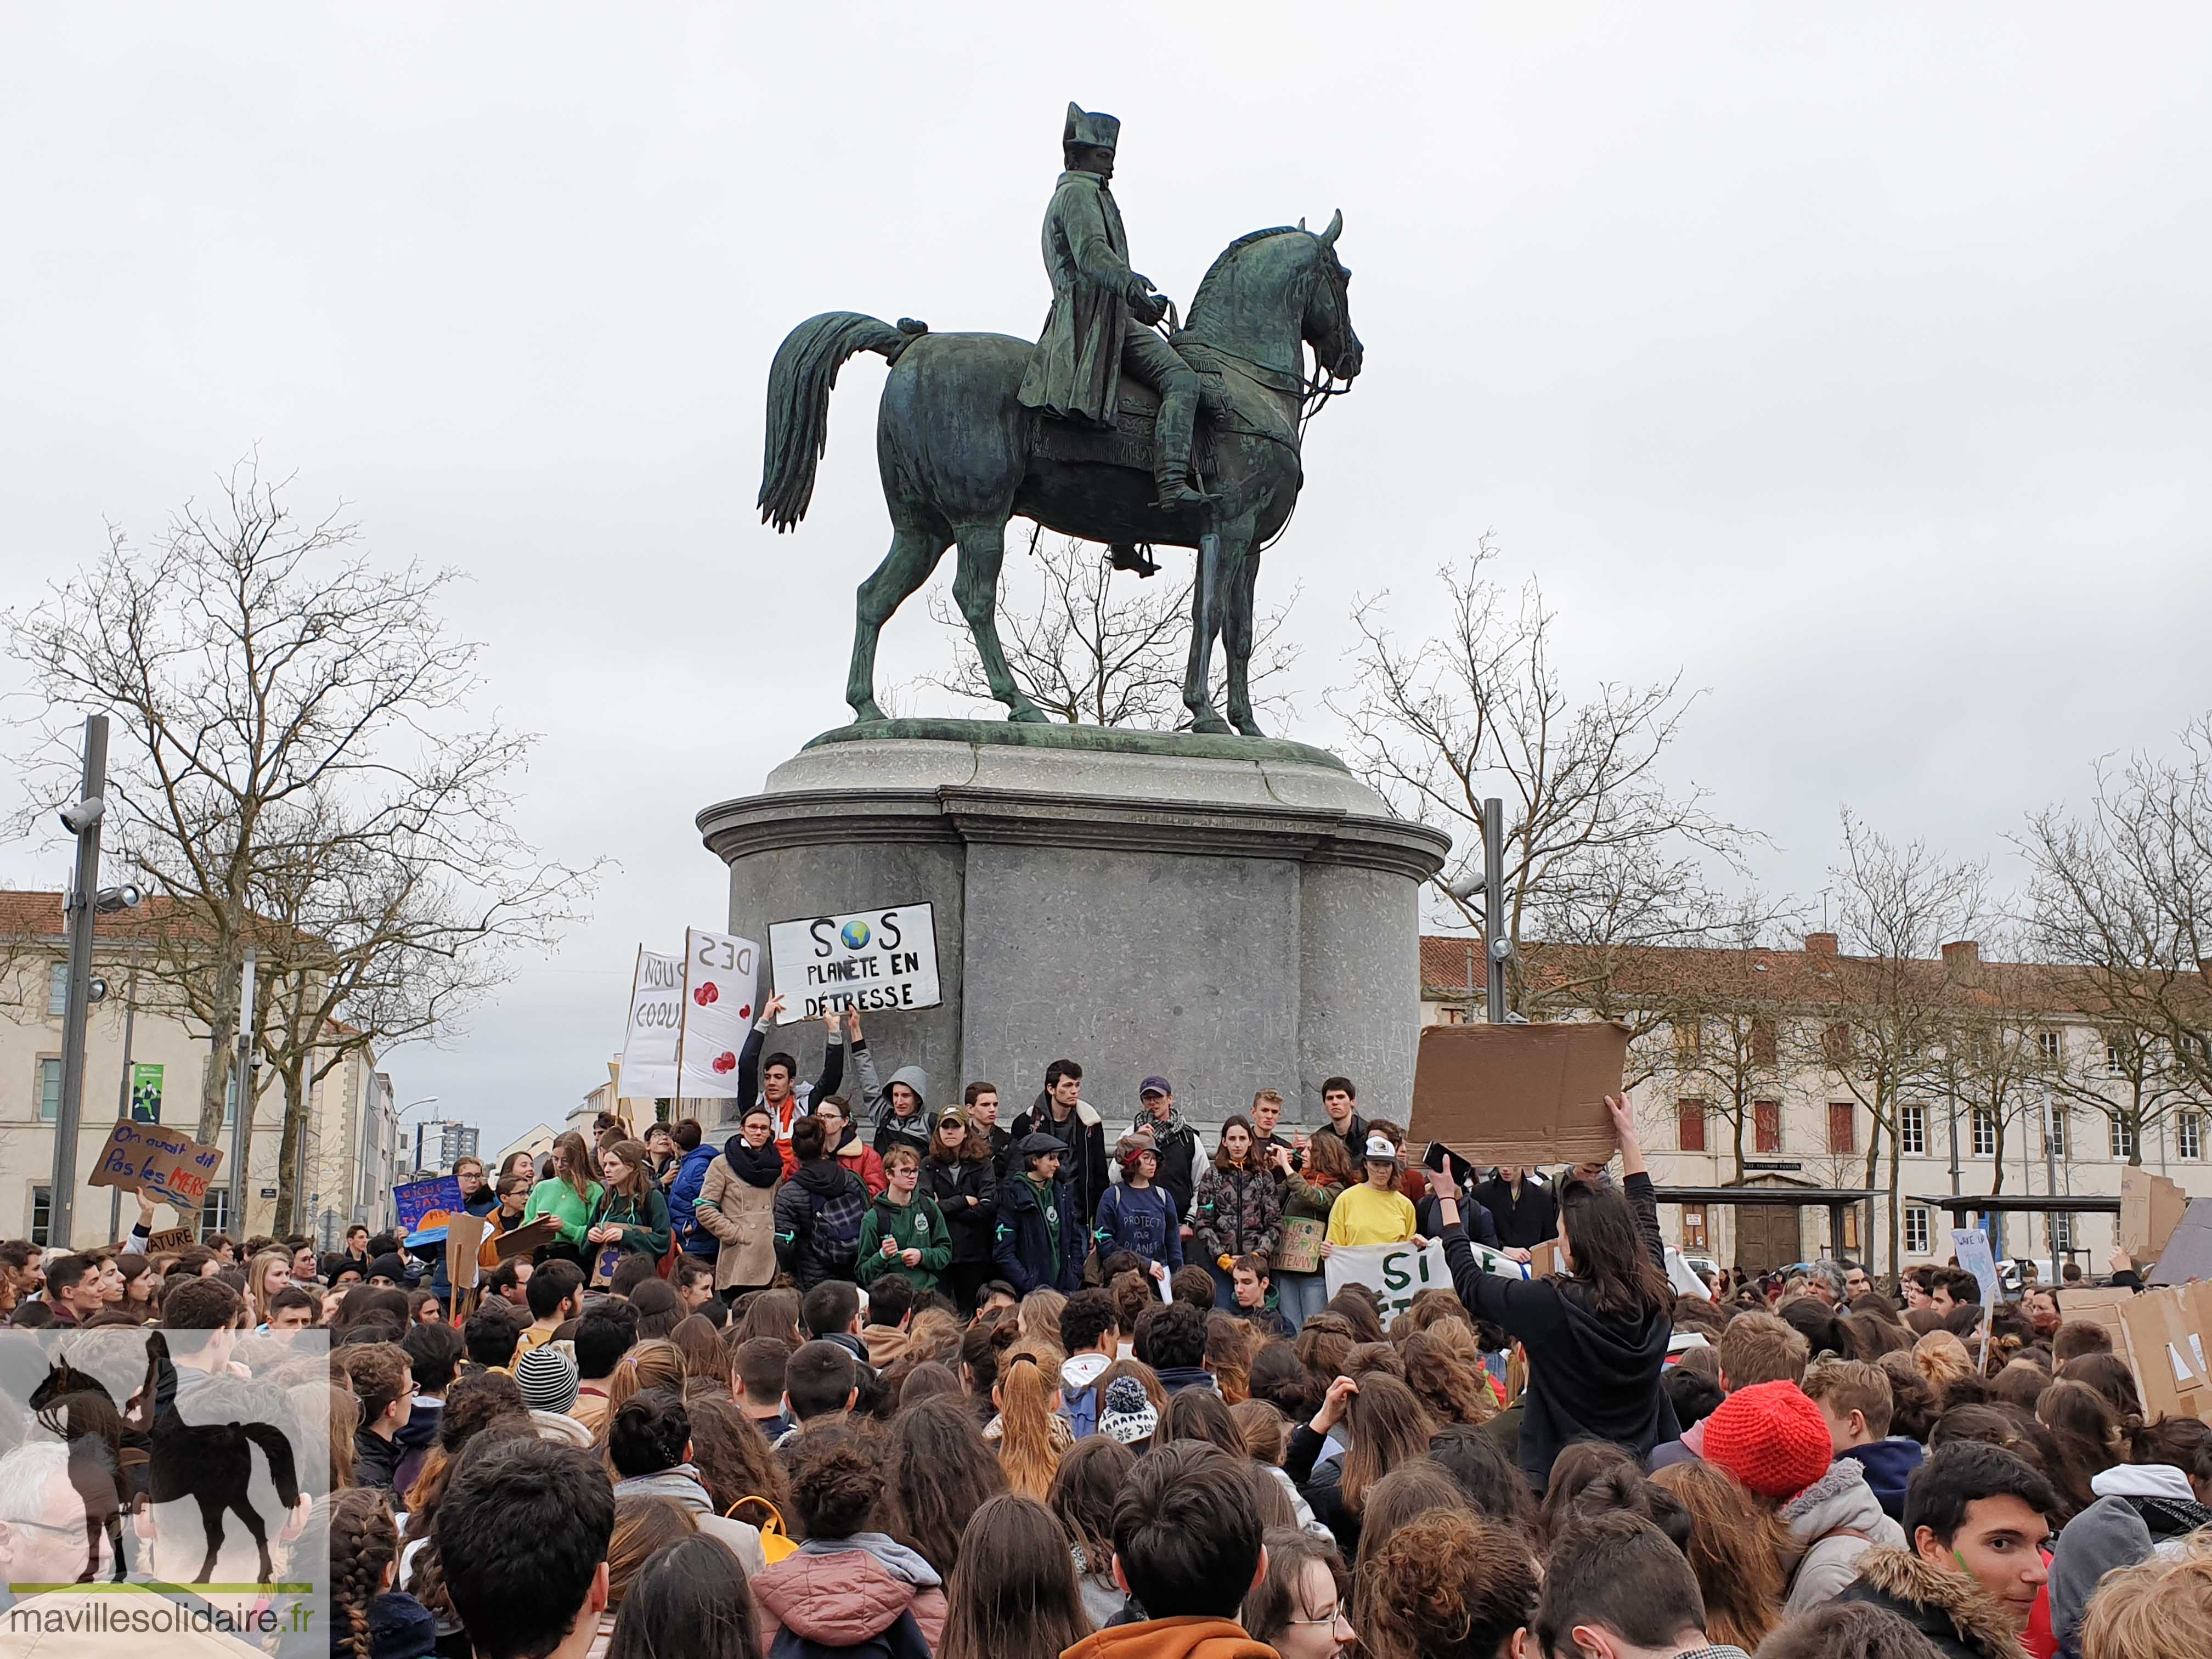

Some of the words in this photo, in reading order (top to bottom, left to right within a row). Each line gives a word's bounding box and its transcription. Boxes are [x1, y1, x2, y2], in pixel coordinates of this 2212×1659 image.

[810, 912, 901, 957] SOS
[808, 955, 879, 986] PLANÈTE
[891, 952, 919, 975] EN
[805, 984, 913, 1017] DÉTRESSE
[636, 1002, 682, 1029] COQU
[114, 1126, 140, 1143] On
[195, 1153, 216, 1169] dit
[104, 1148, 134, 1176] Pas
[139, 1156, 165, 1185] les
[168, 1166, 209, 1197] MERS
[415, 1195, 441, 1210] PAS
[402, 1215, 416, 1225] TA
[1123, 1215, 1161, 1228] PROTECT
[1124, 1241, 1159, 1254] PLANET
[1133, 1230, 1150, 1239] YOUR
[1957, 1235, 1975, 1245] WAKE
[1977, 1234, 1985, 1244] UP
[1382, 1251, 1430, 1291] SI
